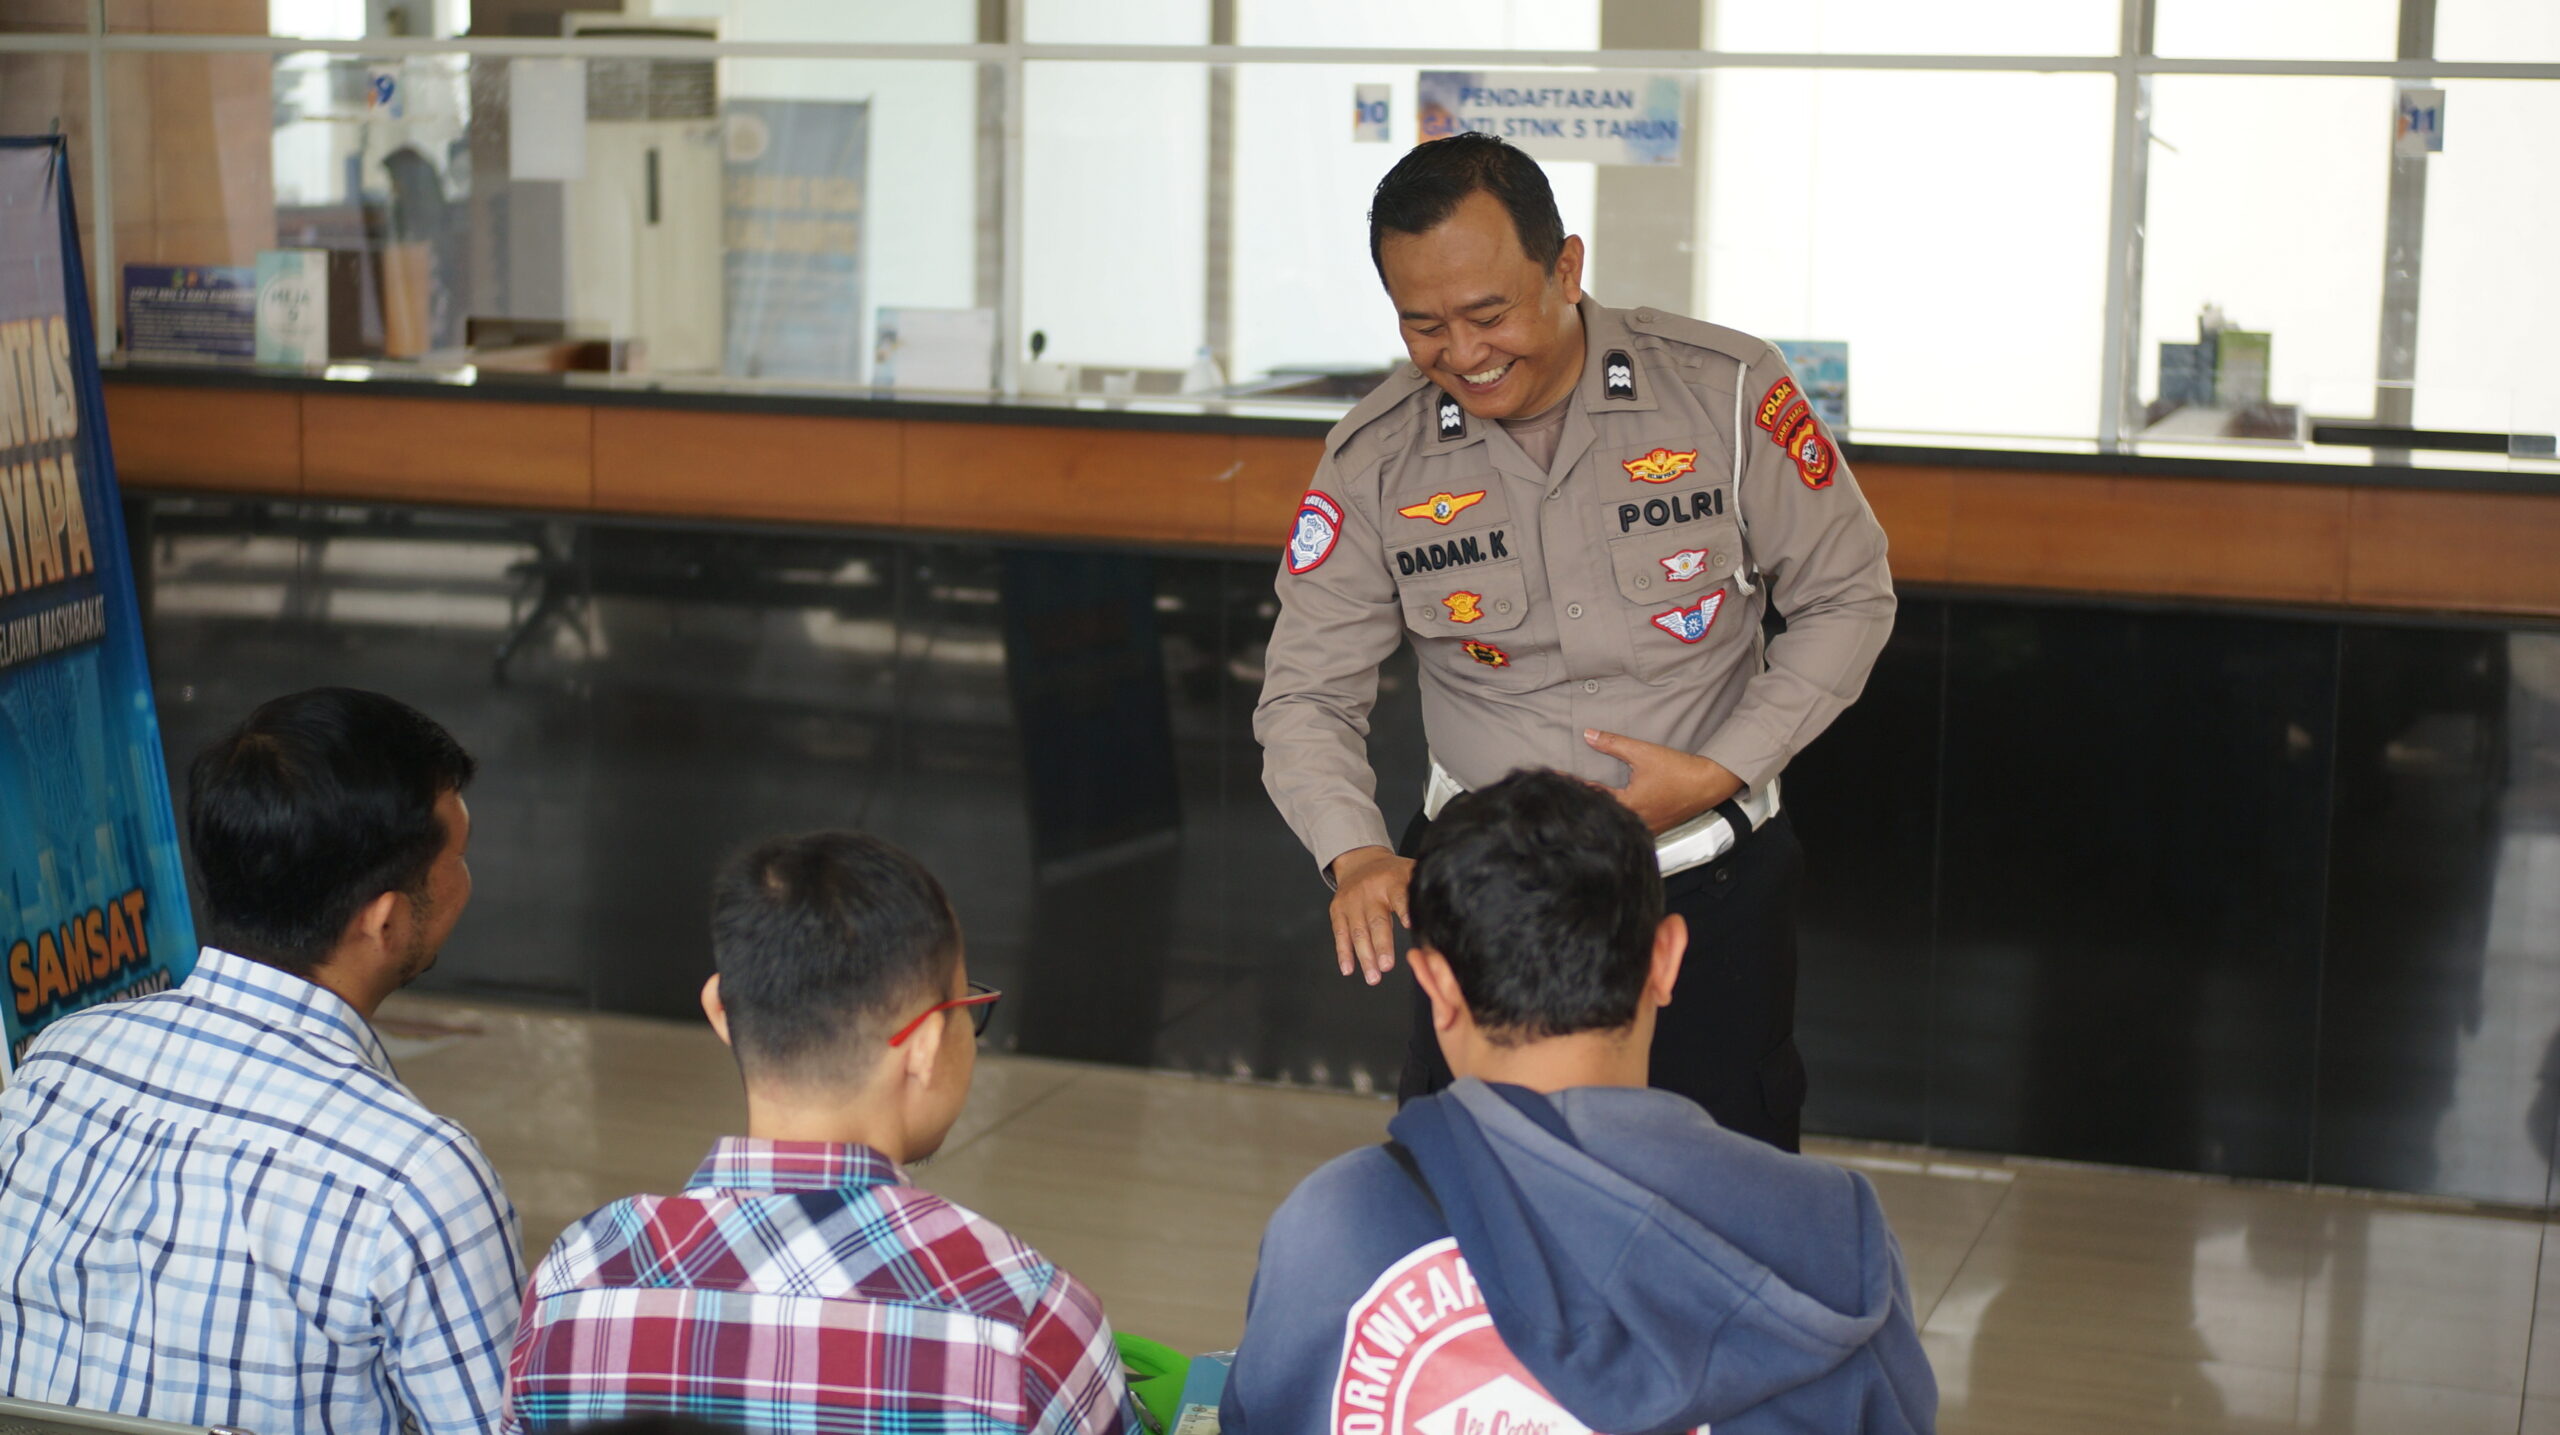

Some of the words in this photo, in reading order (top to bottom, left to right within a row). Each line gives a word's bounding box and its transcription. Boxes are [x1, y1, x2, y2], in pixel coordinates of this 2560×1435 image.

[375, 74, 396, 105] 9
[1459, 87, 1635, 110] PENDAFTARAN
[1357, 100, 1389, 124] 10
[1505, 118, 1563, 138] STNK
[1574, 118, 1587, 138] 5
[1598, 119, 1679, 140] TAHUN
[2407, 107, 2436, 134] 11
[1761, 383, 1792, 425] POLDA
[1618, 488, 1723, 532] POLRI
[1396, 535, 1487, 575] DADAN.
[1489, 530, 1508, 559] K
[40, 594, 106, 654] MASYARAKAT
[10, 889, 148, 1015] SAMSAT
